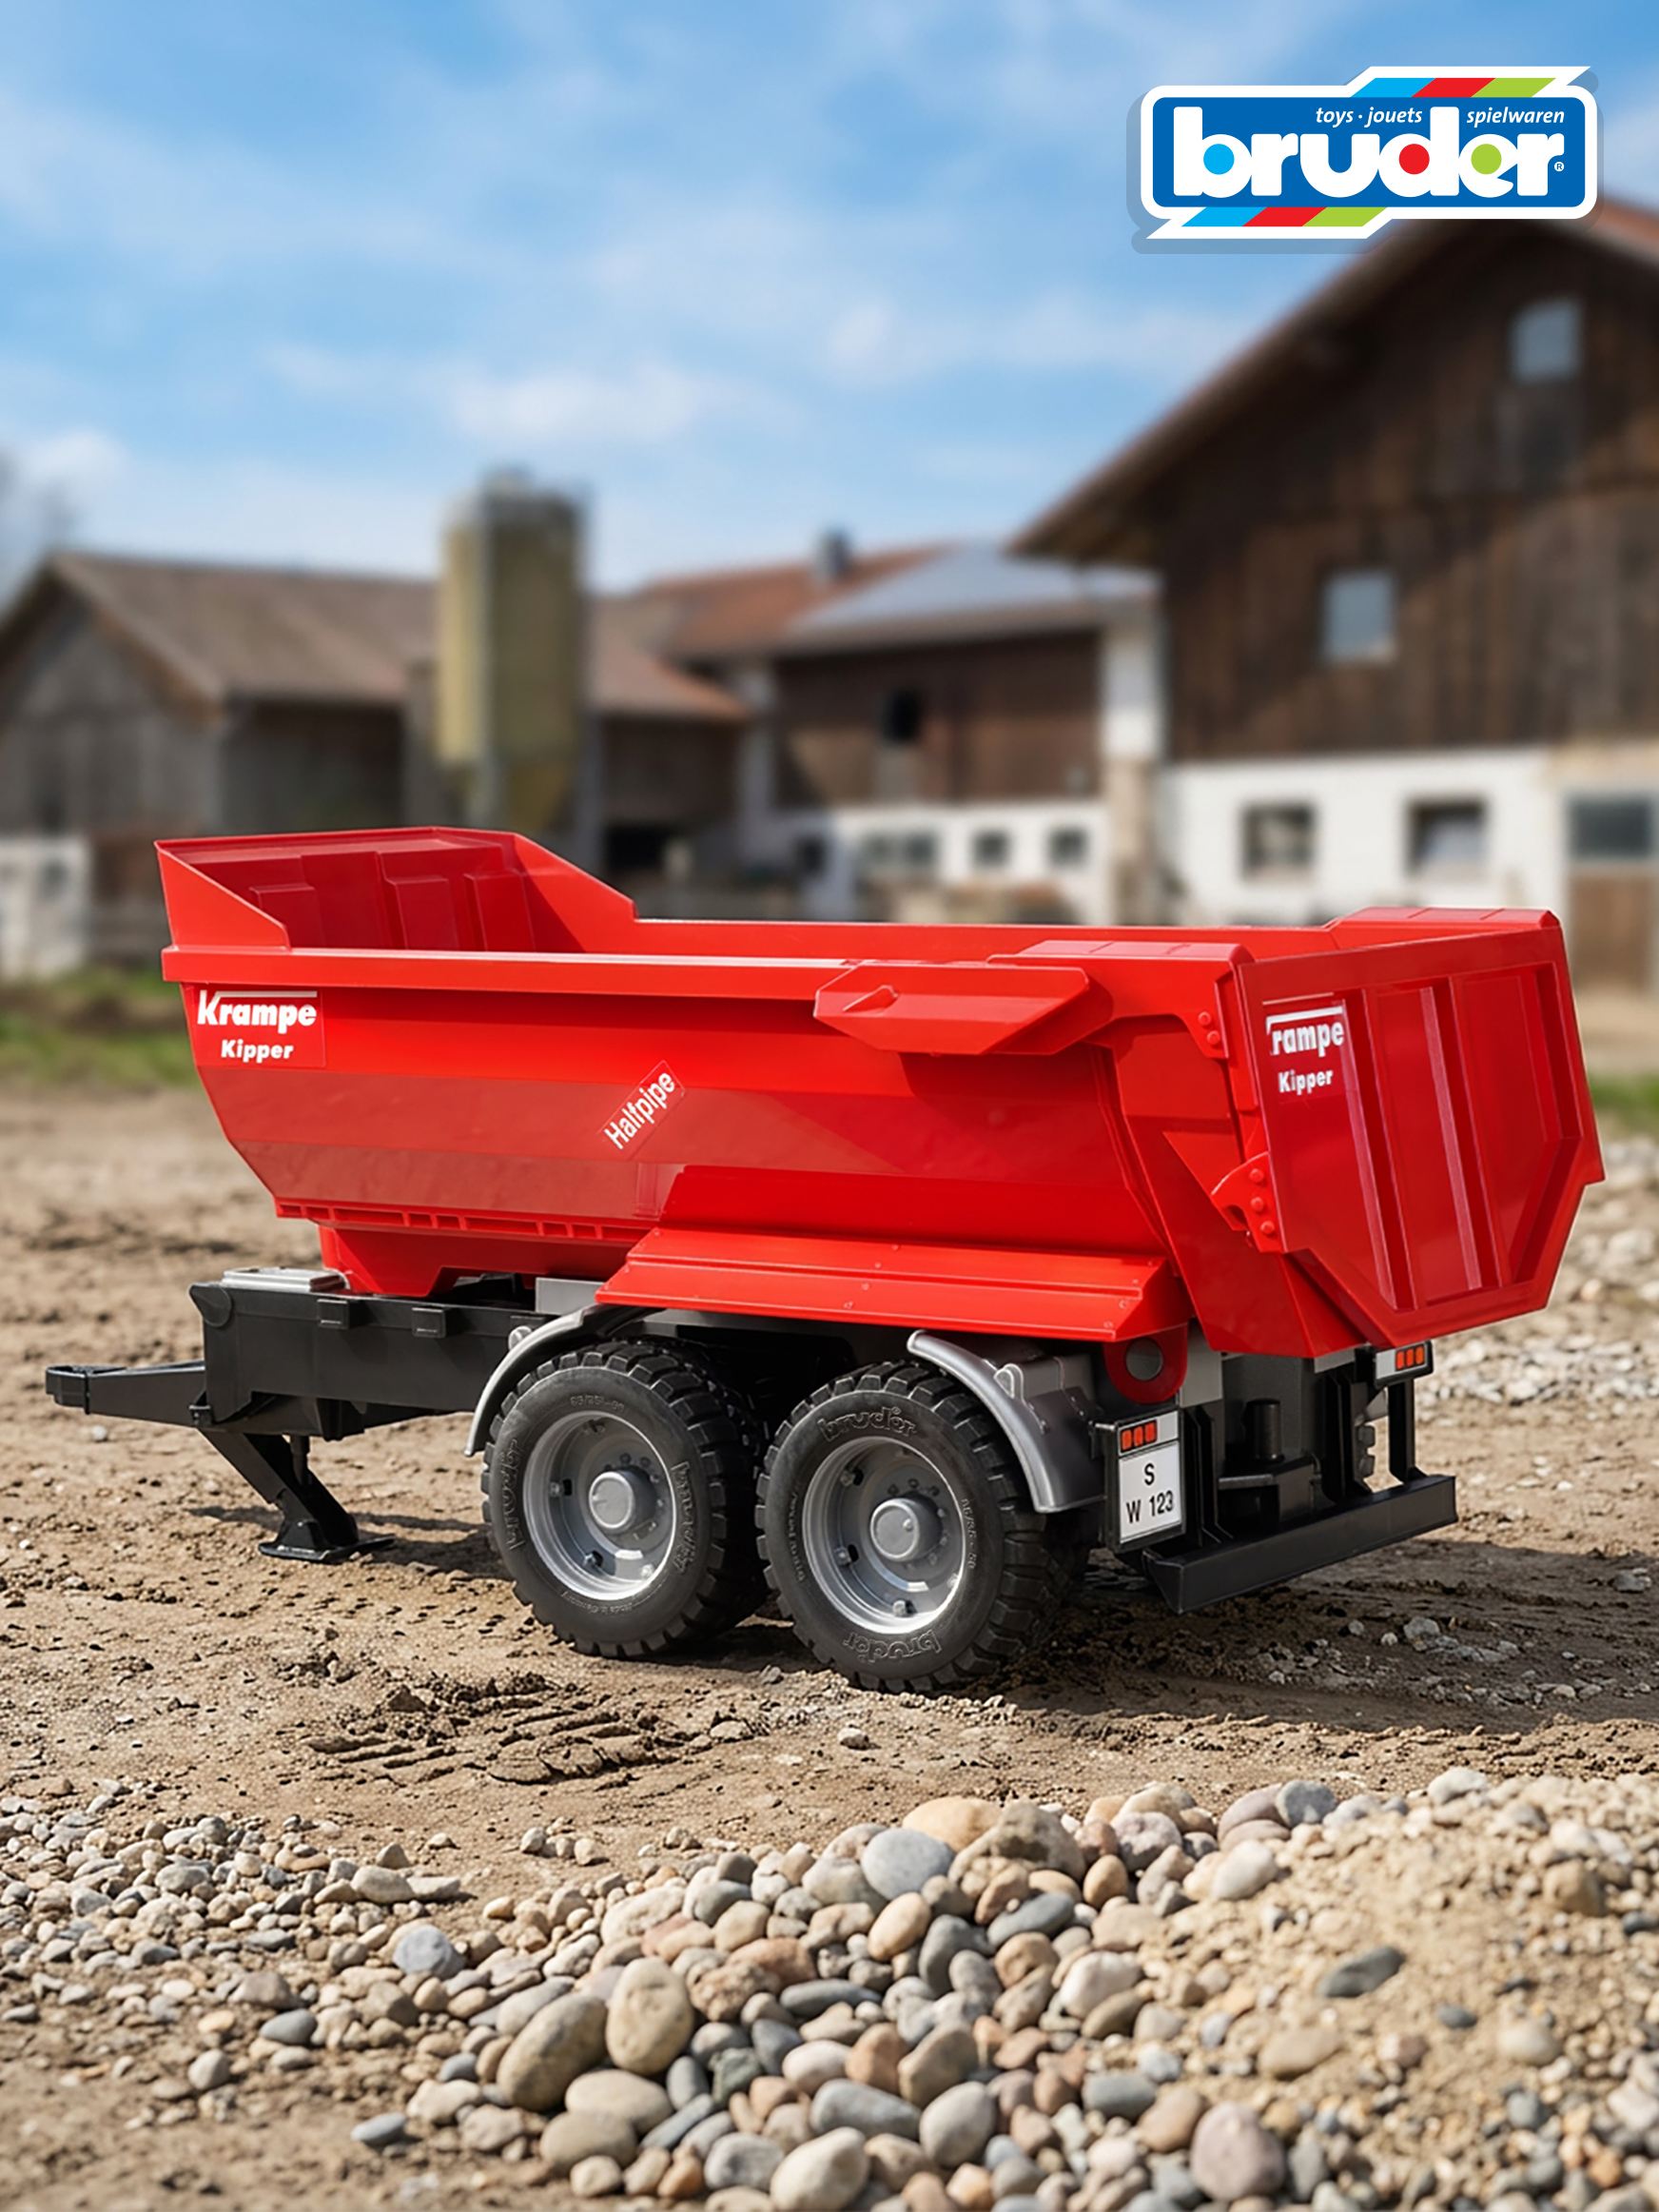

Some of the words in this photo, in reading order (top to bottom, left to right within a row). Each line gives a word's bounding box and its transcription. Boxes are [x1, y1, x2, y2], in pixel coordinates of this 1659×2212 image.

[197, 989, 318, 1034] Krampe
[221, 1039, 294, 1064] Kipper
[1278, 1068, 1334, 1096] Kipper
[603, 1072, 675, 1150] Halfpipe
[1143, 1462, 1155, 1486] S
[1125, 1498, 1142, 1524] W
[1149, 1490, 1174, 1517] 123
